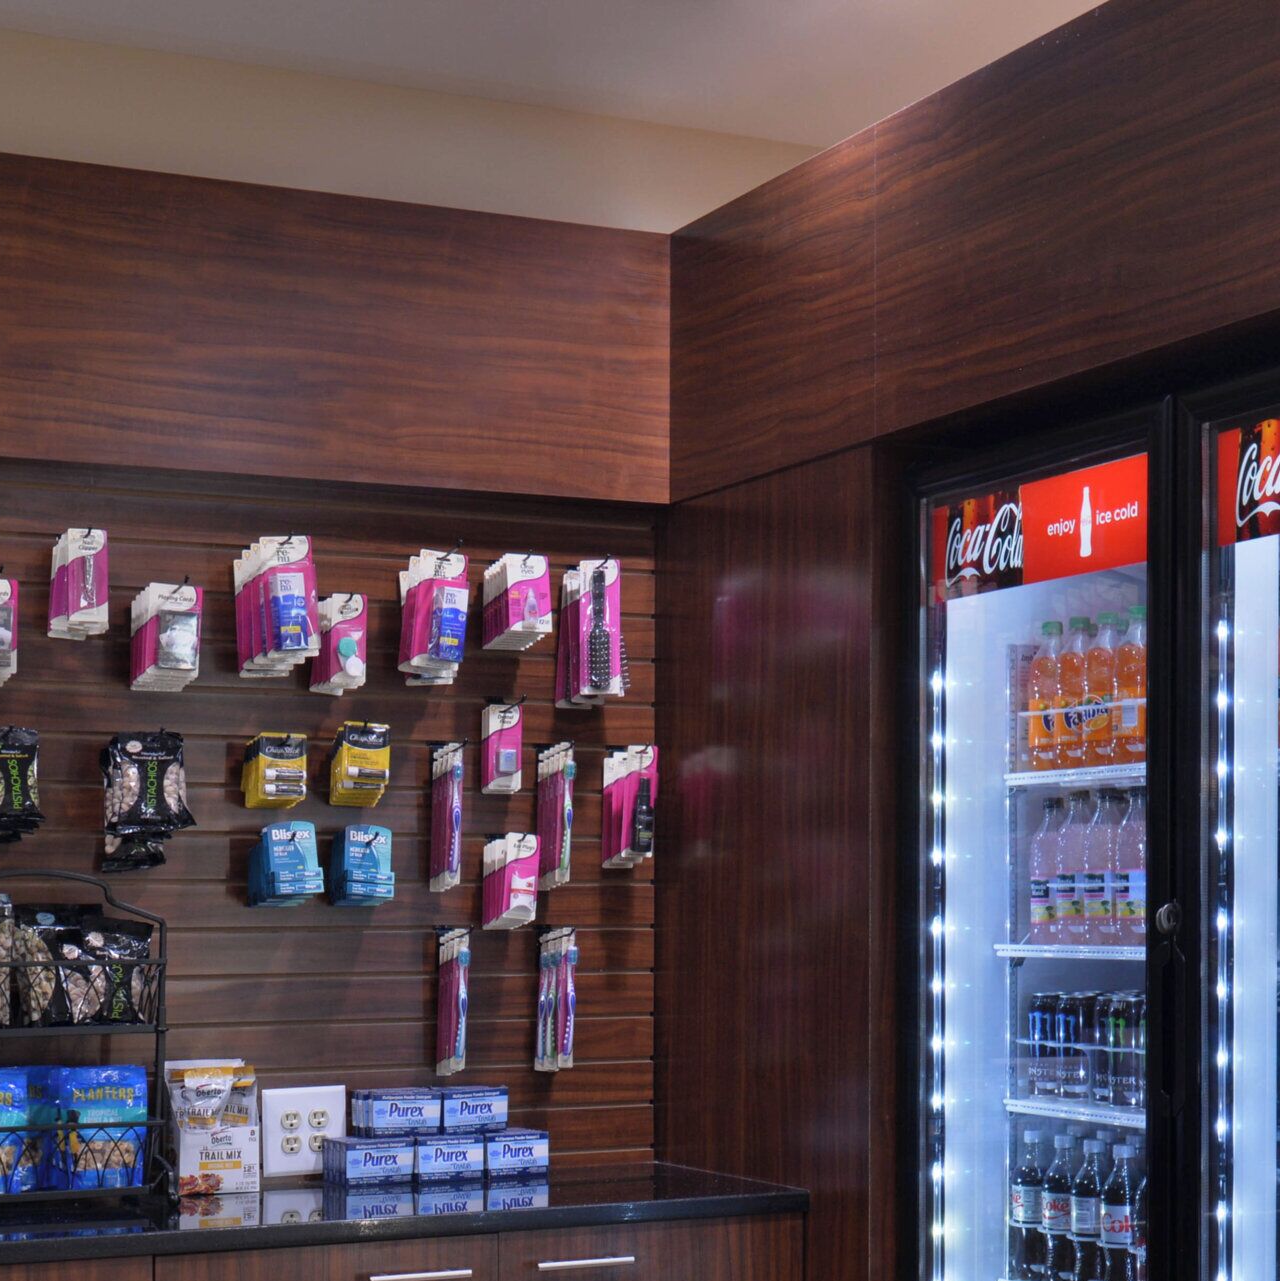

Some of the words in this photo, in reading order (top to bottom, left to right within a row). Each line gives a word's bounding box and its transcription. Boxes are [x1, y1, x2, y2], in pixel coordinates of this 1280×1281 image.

[1096, 510, 1112, 526] ice
[1114, 501, 1139, 522] cold
[1047, 518, 1076, 536] enjoy
[158, 594, 179, 603] Playing
[349, 734, 384, 744] ChapStick
[265, 745, 301, 755] ChapStick
[8, 759, 23, 810] PISTACHIOS
[73, 1086, 135, 1101] PLANTERS
[196, 1087, 222, 1097] Oberto
[237, 1105, 249, 1114] MIX
[389, 1103, 424, 1117] Purex
[459, 1100, 493, 1115] Purex
[211, 1134, 232, 1144] Oberto
[200, 1151, 224, 1161] TRAIL
[226, 1150, 242, 1160] MIX
[434, 1147, 468, 1162] Purex
[502, 1143, 534, 1159] Purex
[363, 1152, 398, 1167] Purex
